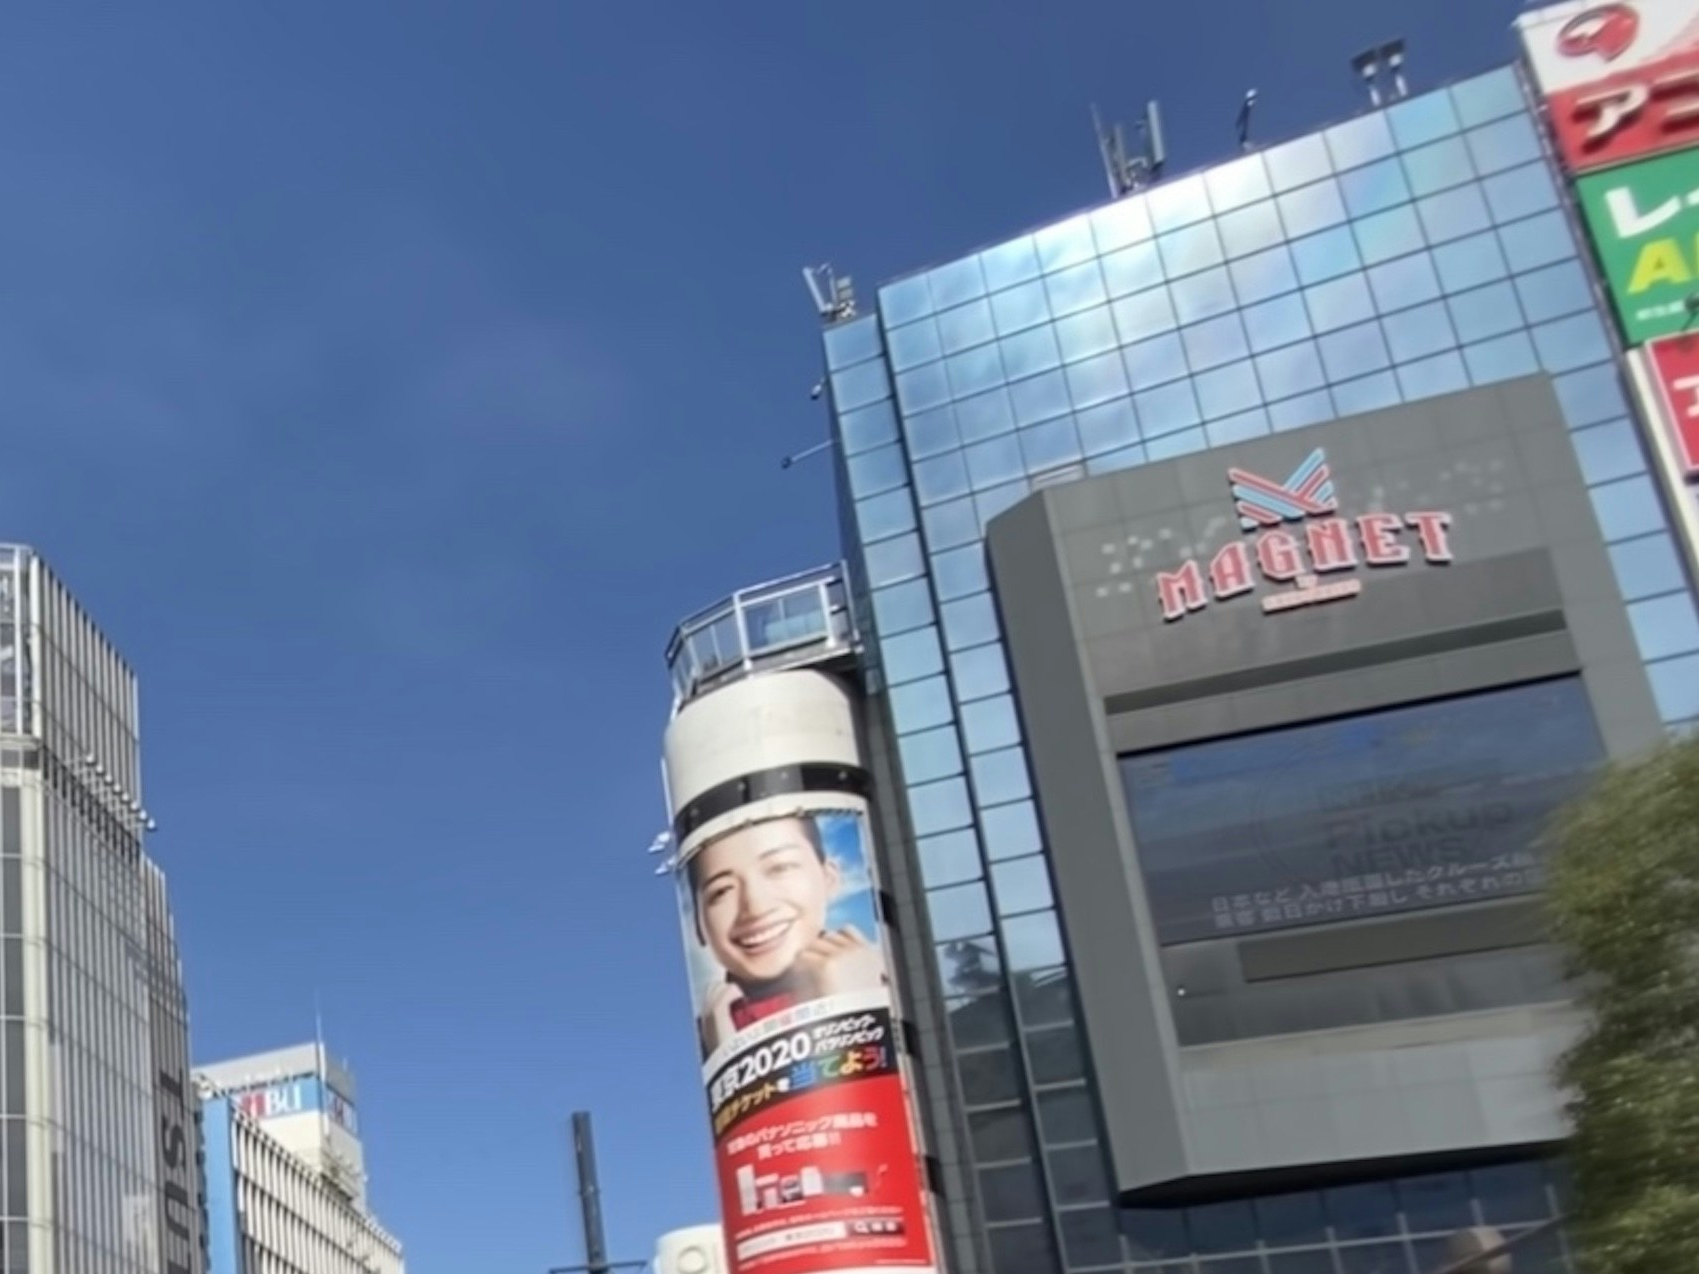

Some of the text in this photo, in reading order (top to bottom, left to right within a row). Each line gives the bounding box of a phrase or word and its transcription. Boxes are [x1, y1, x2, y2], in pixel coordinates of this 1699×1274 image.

[1604, 185, 1699, 239] レ
[1626, 232, 1699, 294] A
[1155, 512, 1455, 621] MAGNET
